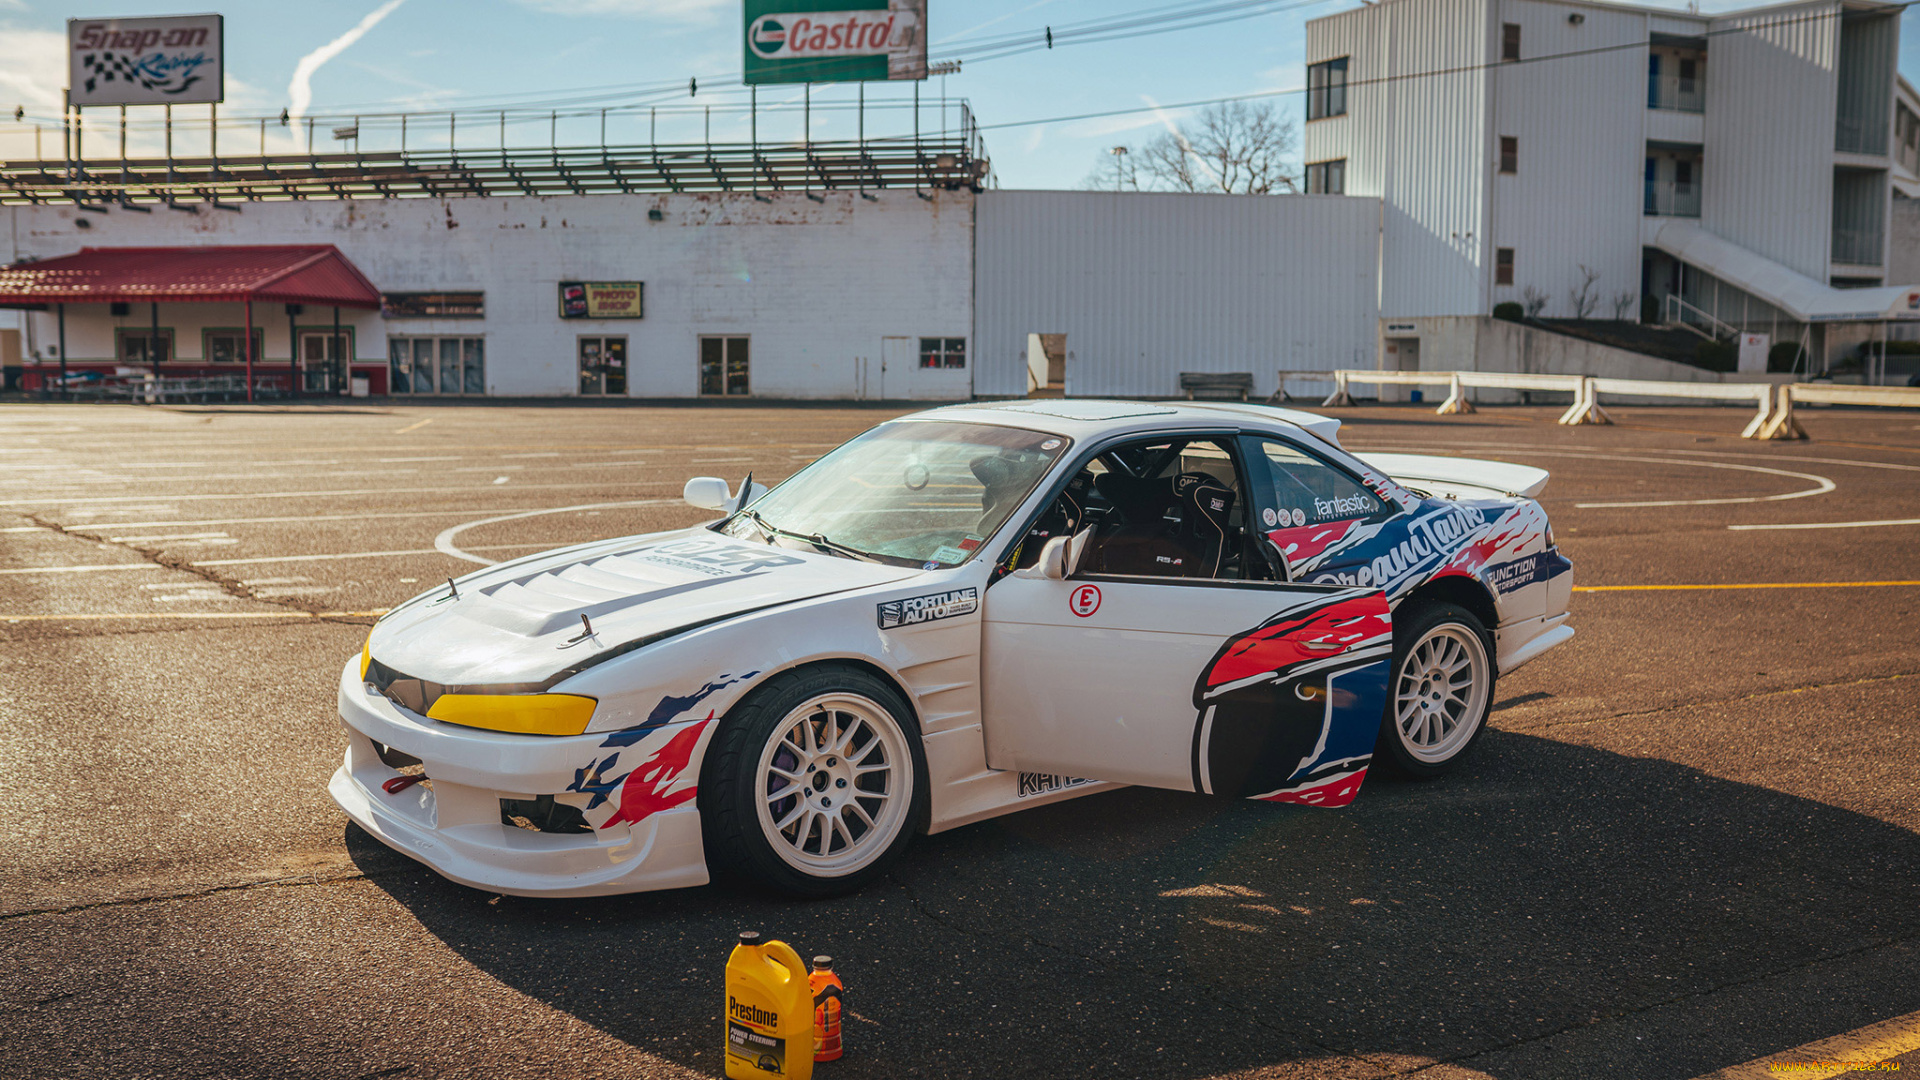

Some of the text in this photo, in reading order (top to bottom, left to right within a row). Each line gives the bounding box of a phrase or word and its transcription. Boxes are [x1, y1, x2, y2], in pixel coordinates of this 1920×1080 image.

[75, 23, 209, 56] Snap-on
[131, 52, 214, 78] Racing
[592, 290, 637, 300] PHOTO
[597, 301, 631, 310] SHOP
[1313, 512, 1343, 521] voyages
[1345, 507, 1379, 517] unlimited
[1314, 493, 1370, 515] fantastic
[1487, 557, 1536, 583] FUNCTION
[1495, 571, 1535, 591] TORSPORTS
[903, 588, 976, 612] FORTUNE
[1079, 588, 1094, 607] E
[904, 605, 947, 624] AUTO
[730, 995, 777, 1027] Prestone
[730, 1026, 777, 1047] POWER STEERING
[730, 1033, 744, 1045] FLUID
